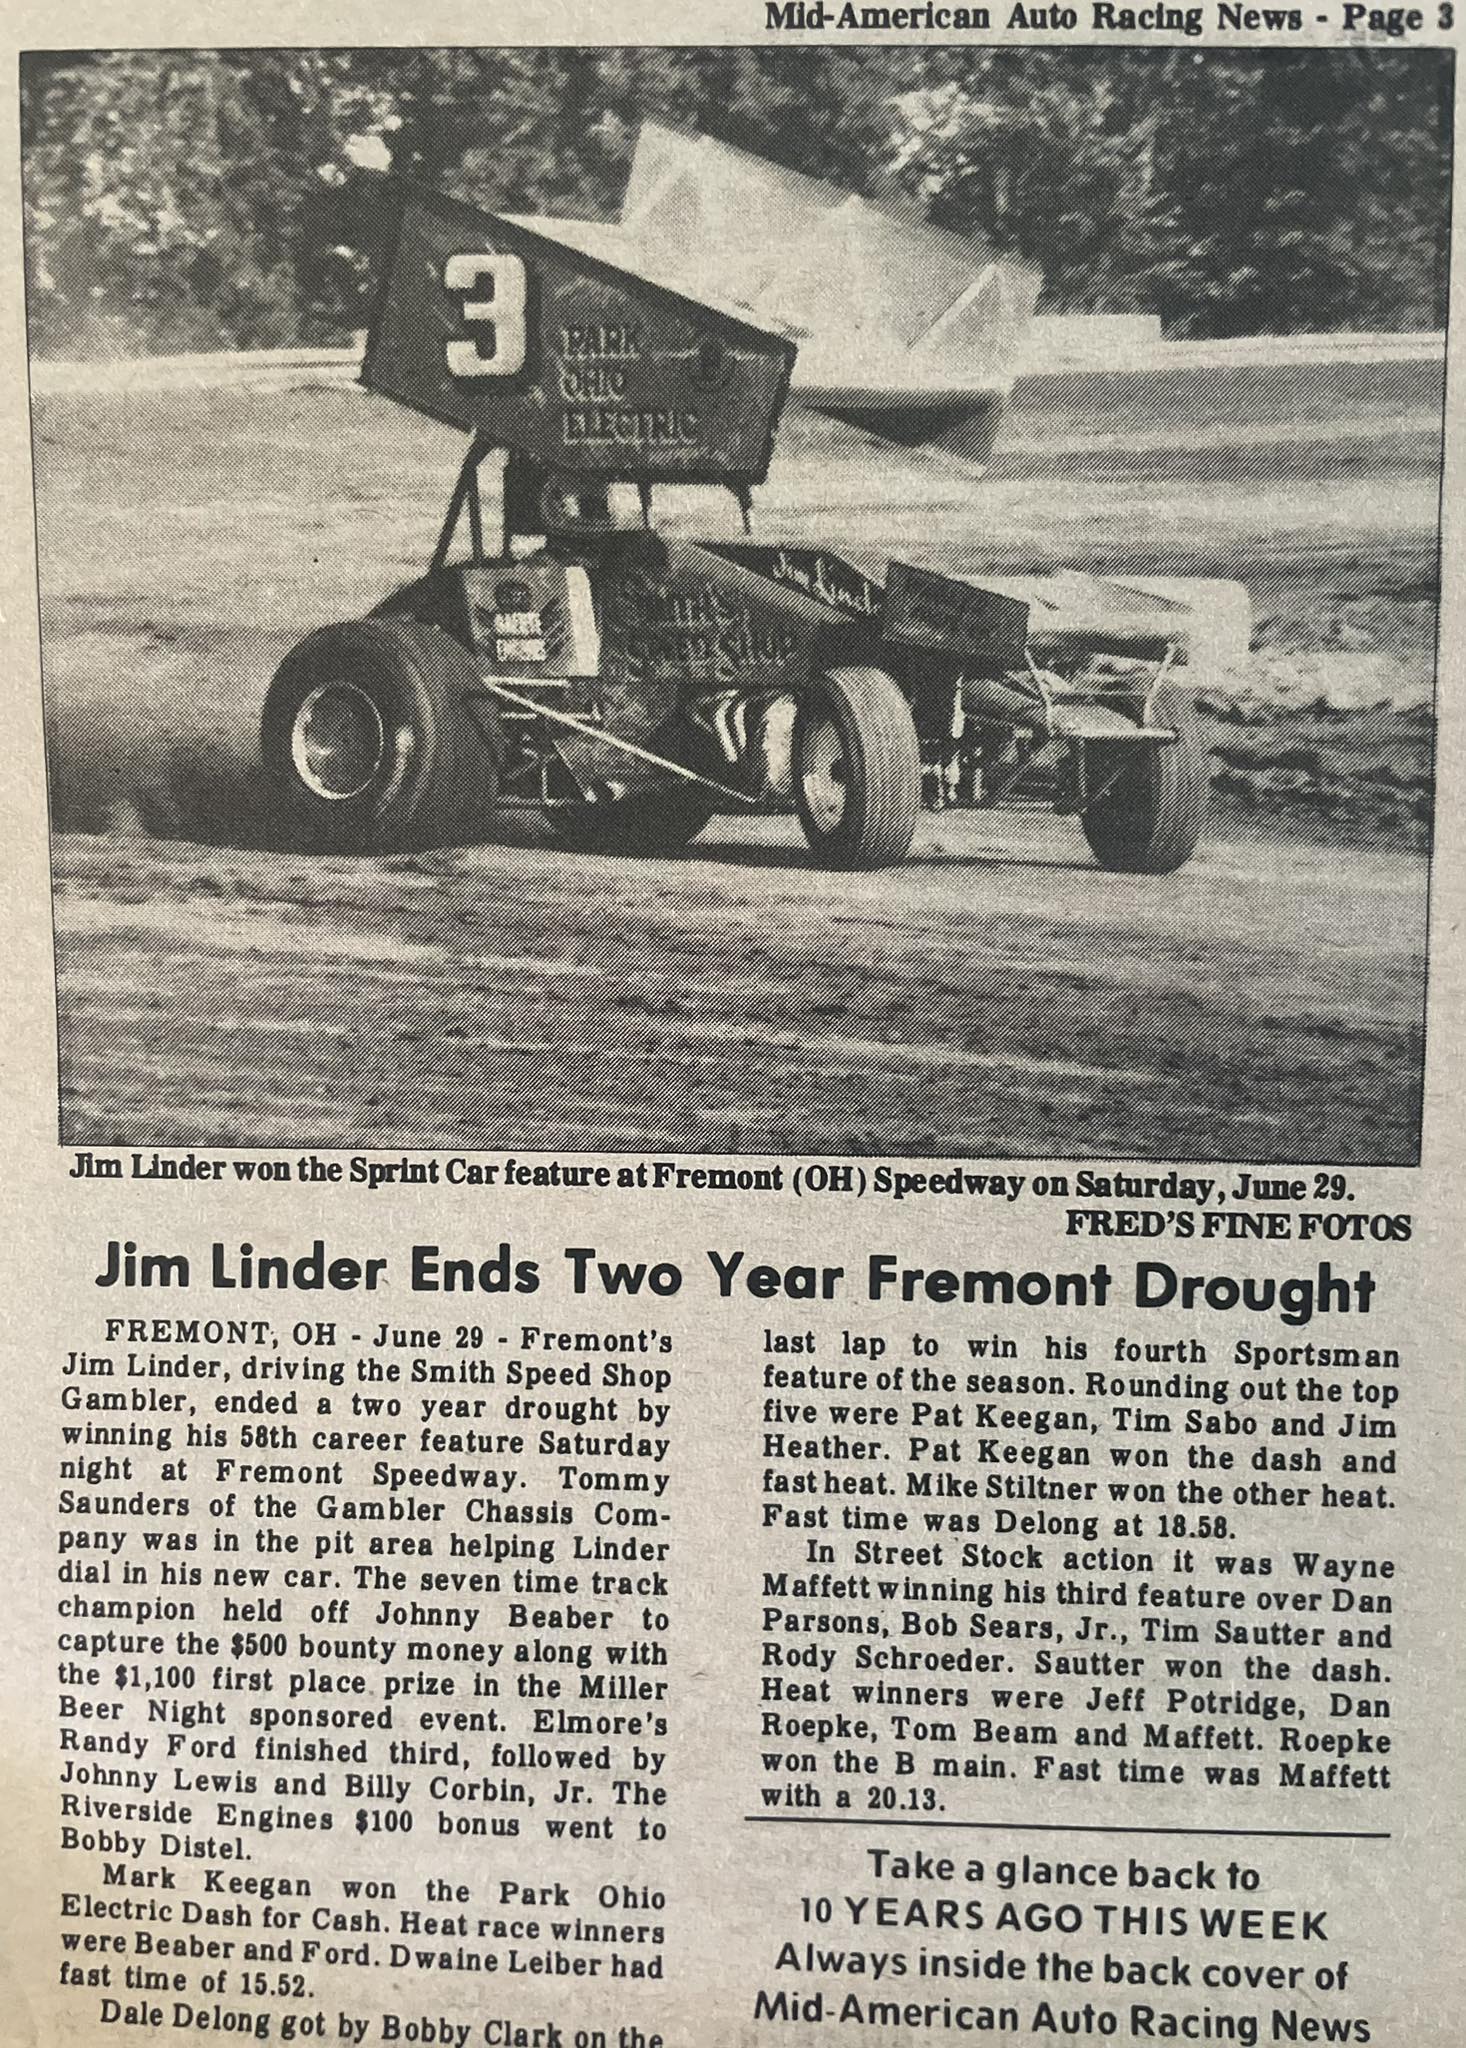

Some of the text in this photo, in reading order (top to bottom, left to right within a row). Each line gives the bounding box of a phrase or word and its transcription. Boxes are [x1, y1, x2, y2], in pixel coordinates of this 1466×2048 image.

[764, 0, 991, 30] Mid-American
[1006, 2, 1078, 30] Auto
[1092, 2, 1203, 36] Racing
[1217, 2, 1303, 31] News
[1342, 3, 1423, 37] Page
[1438, 1, 1454, 30] 3
[445, 254, 528, 378] 3
[561, 325, 641, 360] PARK
[557, 367, 625, 402] OHIO
[562, 409, 701, 447] ELECTRIC
[68, 1152, 1355, 1206] Jim Linder won the Sprint Car feature at Fremont (OH) Speedway on Saturday, June 29.
[1065, 1209, 1413, 1242] FRED'S FINE FOTOS
[94, 1239, 1376, 1326] Jim Linder Ends Two Year Fremont Drought
[105, 1318, 279, 1350] FREMONT,
[292, 1321, 337, 1346] OH
[372, 1323, 442, 1349] June
[455, 1325, 484, 1349] 29
[520, 1326, 673, 1354] Fremont's
[763, 1328, 1400, 1371] last lap to win his fourth Sportsman
[61, 1351, 672, 1394] Jim Linder, driving the Smith Speed Shop
[762, 1433, 1397, 1474] Heather. Pat Keegan won the dash and
[59, 1455, 671, 1498] night at Fremont Speedway. Tommy
[806, 1538, 1395, 1583] In Street Stock action it was Wayne
[57, 1594, 670, 1633] champion held off Johnny Beaber to
[762, 1607, 1393, 1649] Parsons, Bob Sears, Jr., Tim Sautter and
[57, 1661, 669, 1701] the $1,100 first place prize in the Miller
[761, 1642, 1391, 1683] Rody Schroeder. Sautter won the dash.
[58, 1694, 668, 1737] Beer Night sponsored event. Elmore's
[60, 1793, 667, 1842] Riverside Engines $100 bonus went to
[760, 1782, 946, 1812] with a 20.13.
[102, 1862, 666, 1911] Mark Keegan won the Park Ohio
[866, 1848, 1260, 1892] Take a glance back to
[800, 1896, 1329, 1941] 10 YEARS AGO THIS WEEK
[774, 1941, 1349, 1991] Always inside the back cover of
[753, 1989, 1371, 2048] Mid-American Auto Racing News
